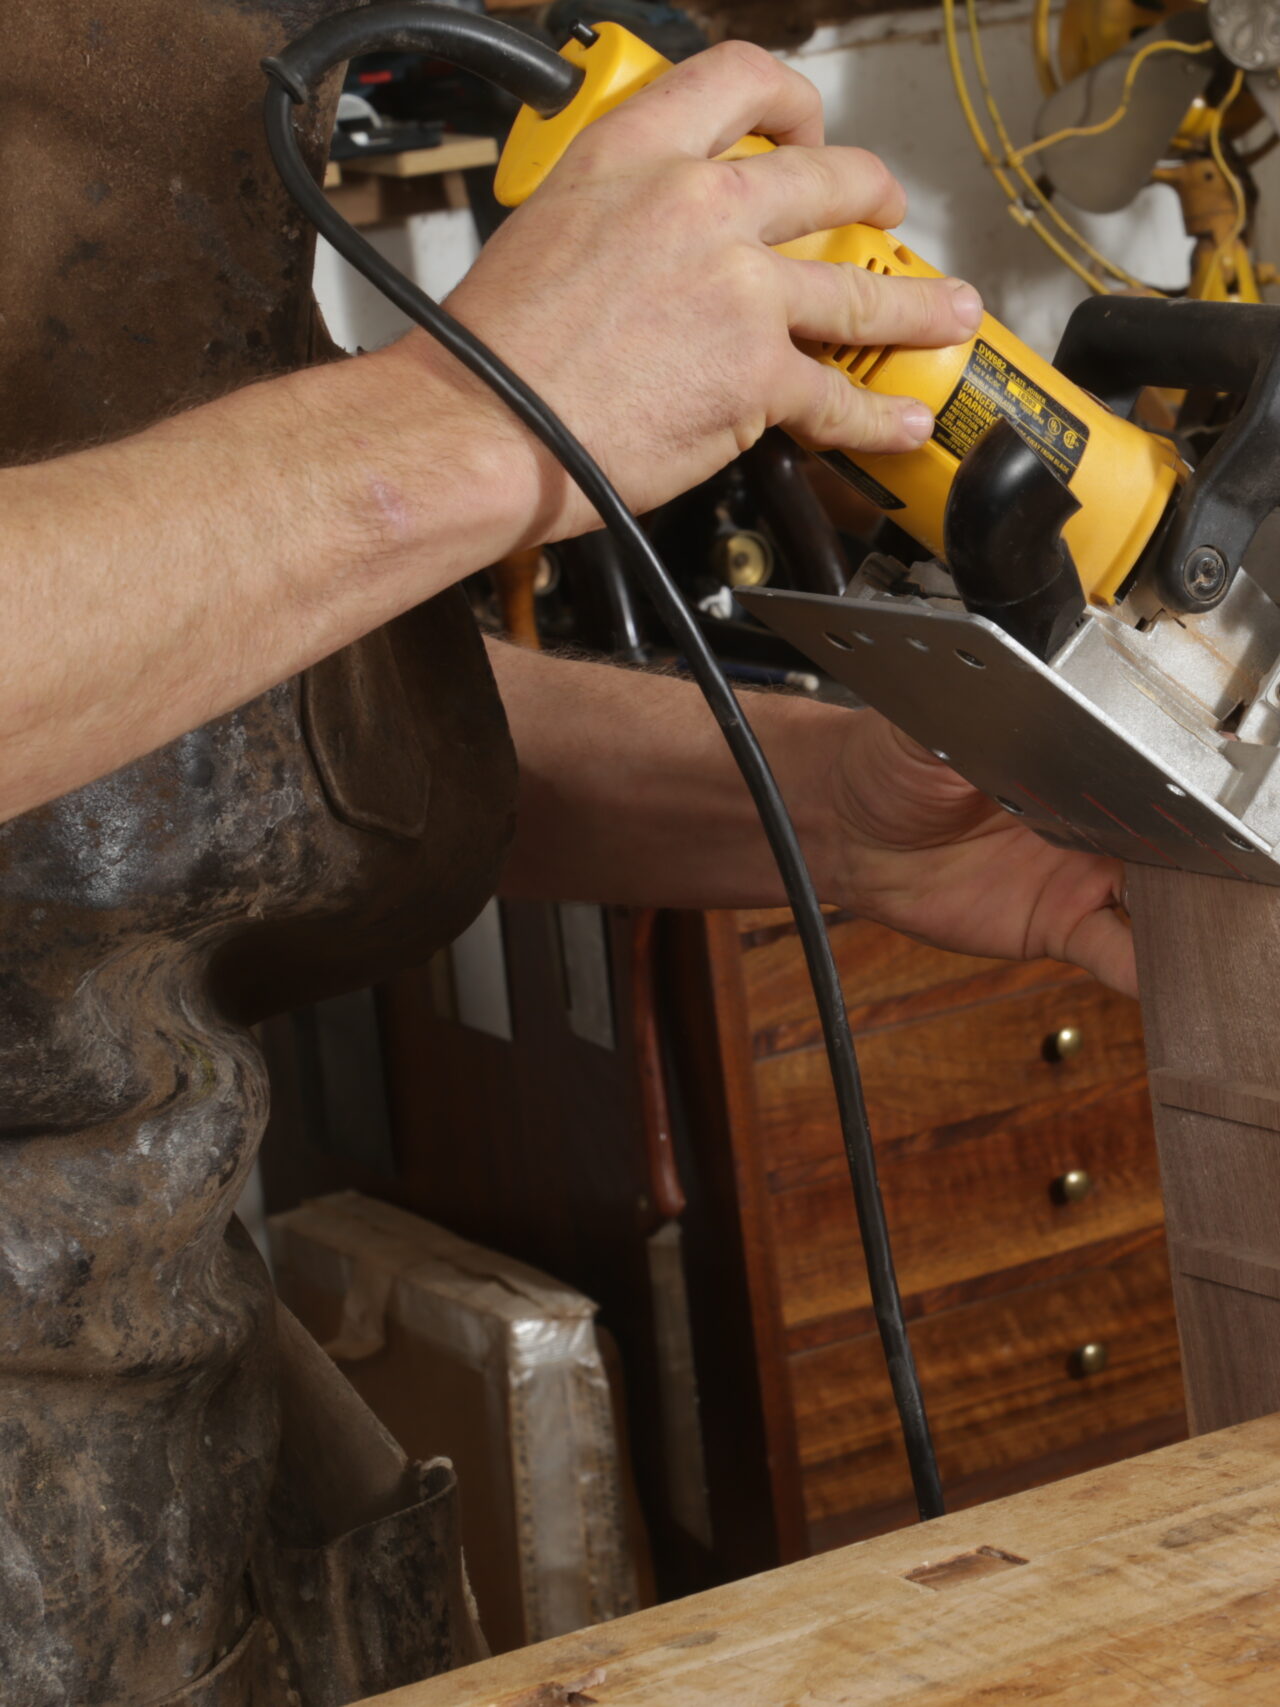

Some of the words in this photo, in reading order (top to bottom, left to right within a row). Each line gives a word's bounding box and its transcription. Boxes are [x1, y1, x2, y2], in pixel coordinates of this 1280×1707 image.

[976, 356, 988, 369] TYPE
[979, 344, 1007, 372] DW682
[1010, 372, 1026, 389] PLATE
[1027, 386, 1046, 405] JOINER
[953, 399, 985, 427] INSTRUCTION
